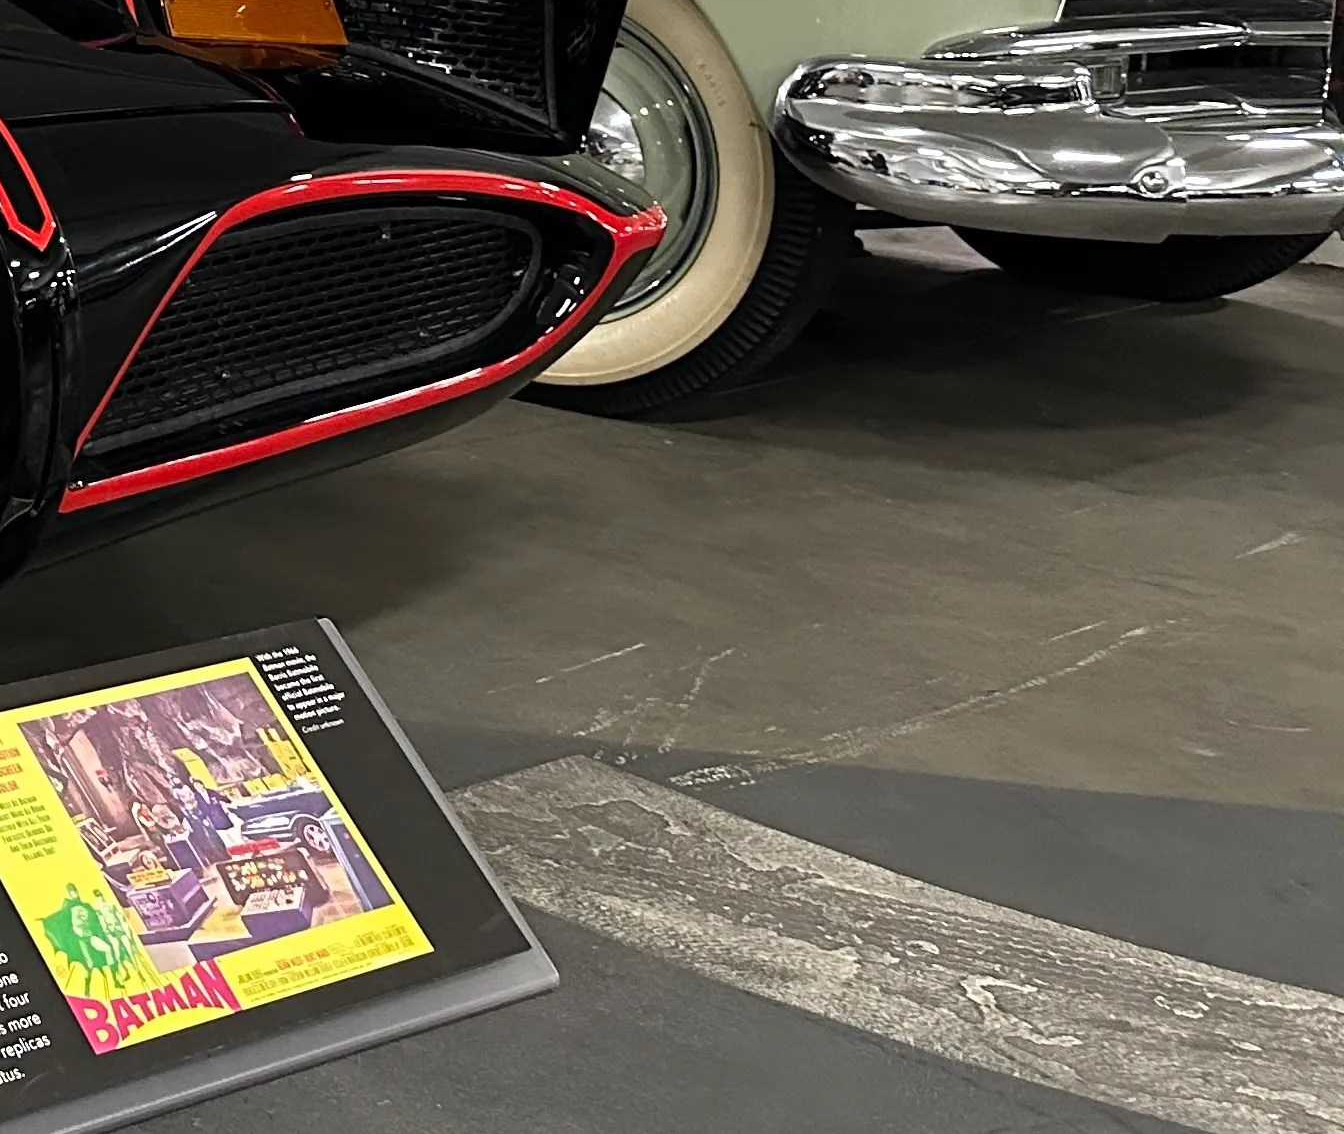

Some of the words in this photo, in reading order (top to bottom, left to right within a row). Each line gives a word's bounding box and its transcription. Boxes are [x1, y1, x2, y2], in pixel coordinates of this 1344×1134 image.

[2, 993, 29, 1009] four
[65, 958, 242, 1055] BATMAN
[7, 1014, 41, 1032] more
[0, 1035, 51, 1059] replicas
